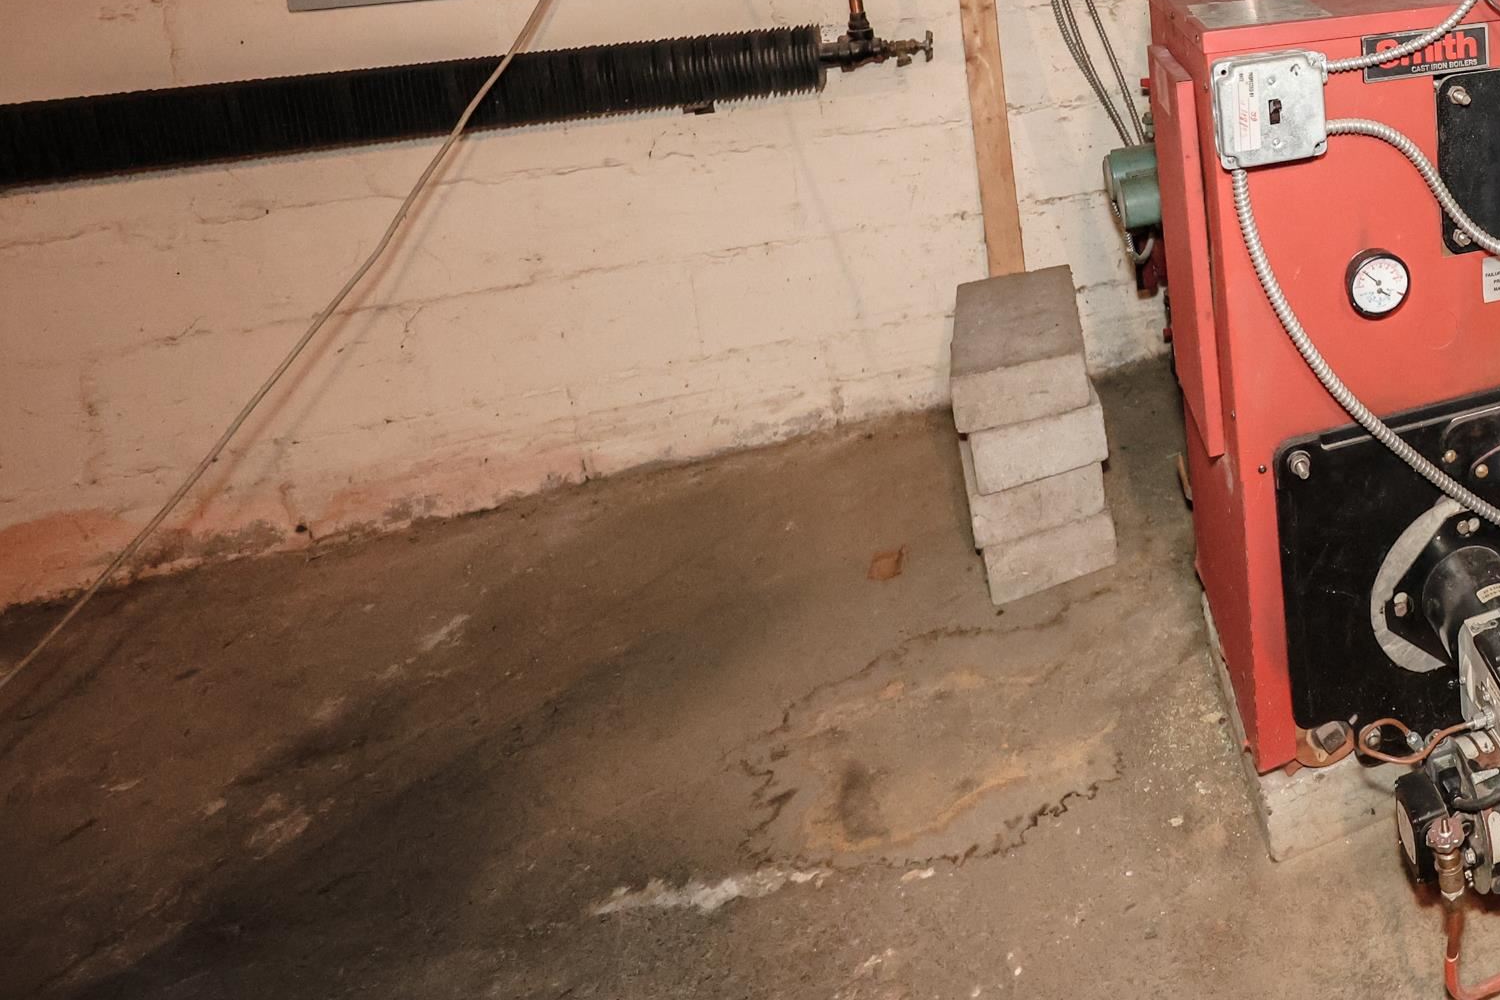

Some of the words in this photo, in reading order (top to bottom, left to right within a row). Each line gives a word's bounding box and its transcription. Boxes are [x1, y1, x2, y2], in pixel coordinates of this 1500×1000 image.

[1411, 64, 1430, 73] CAST
[1430, 62, 1448, 71] IRON
[1448, 58, 1478, 68] BOILERS
